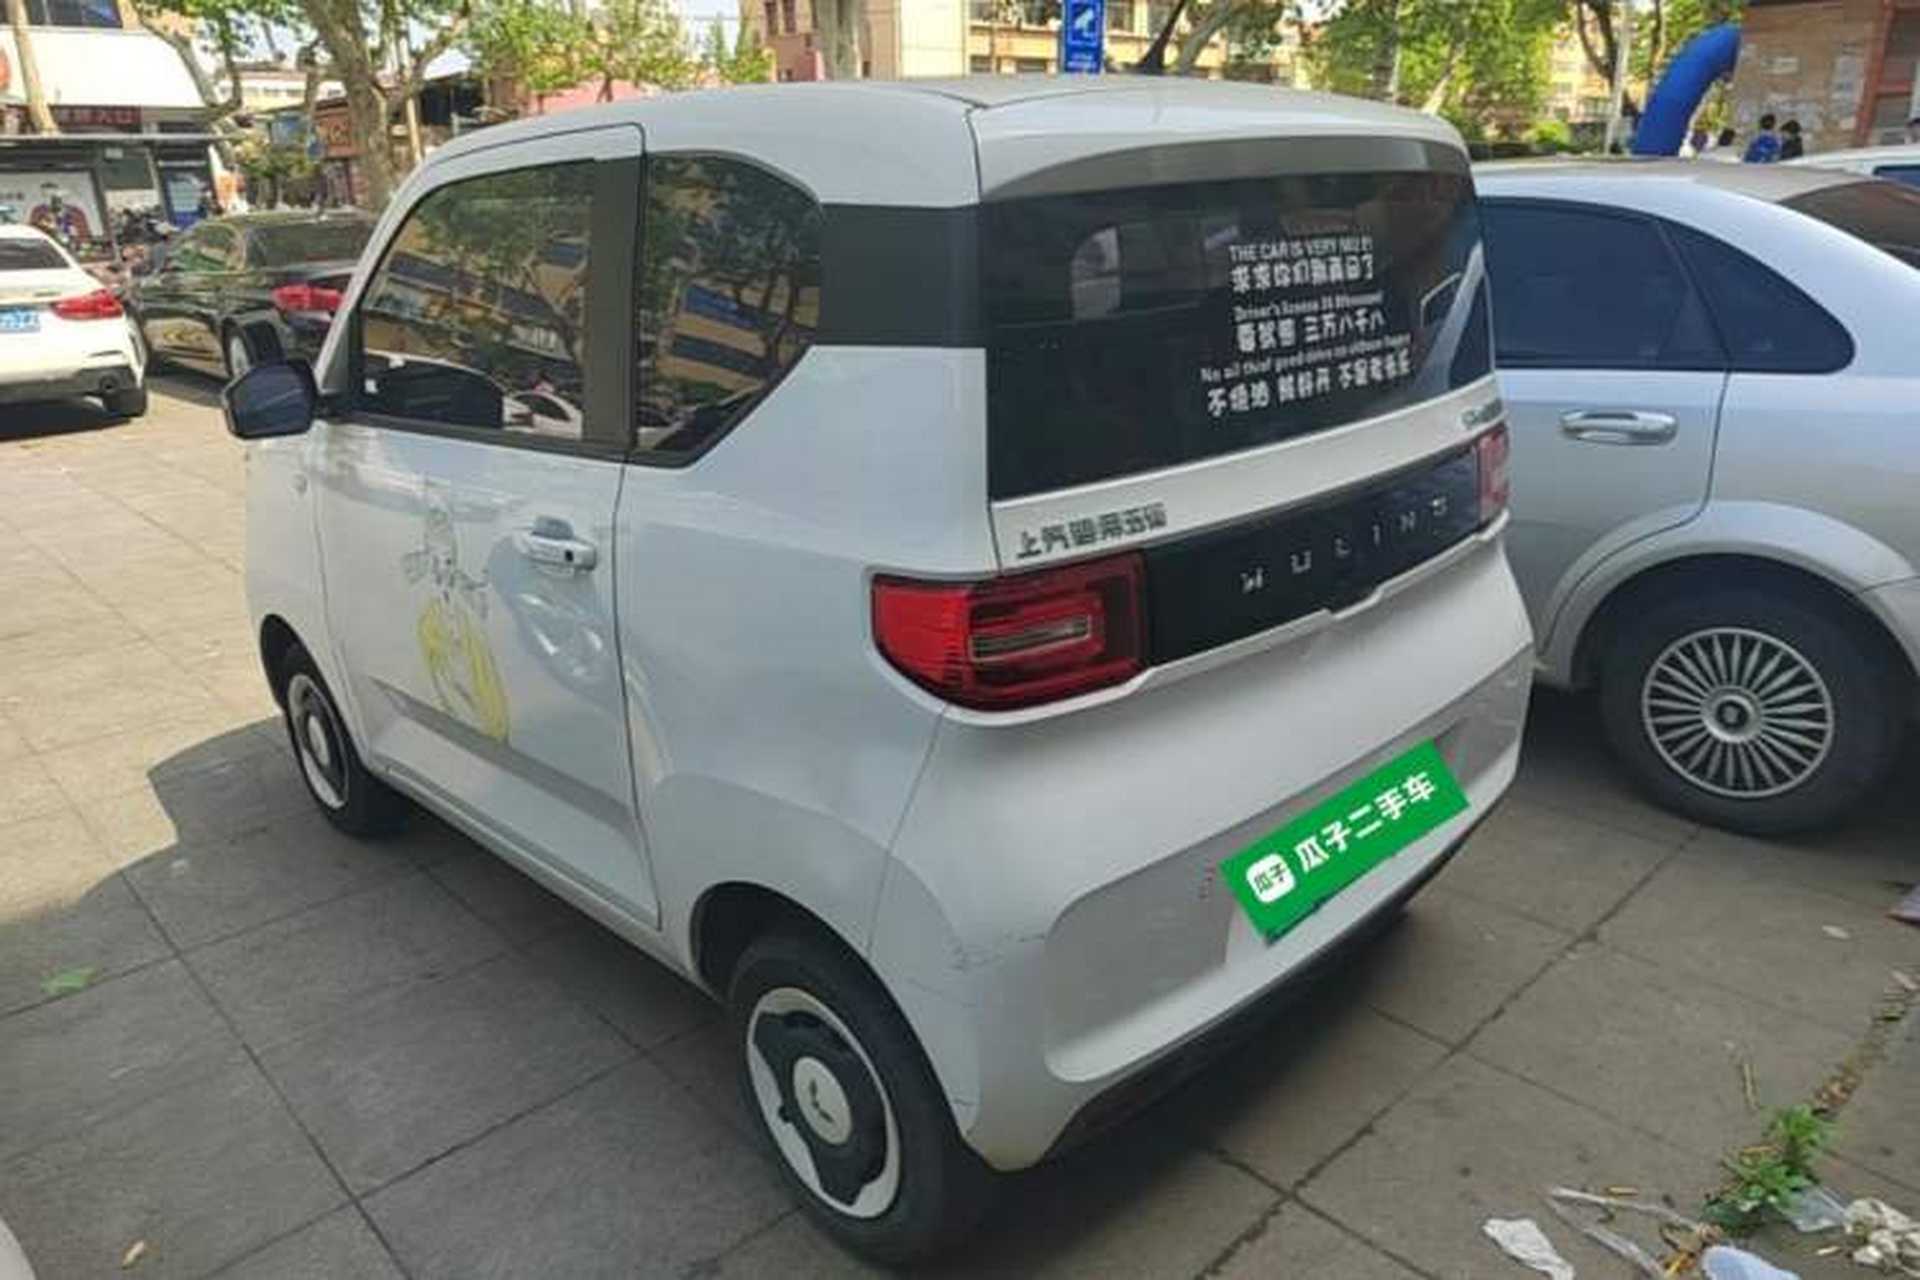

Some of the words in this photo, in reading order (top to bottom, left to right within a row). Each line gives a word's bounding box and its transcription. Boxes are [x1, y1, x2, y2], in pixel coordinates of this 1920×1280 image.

[1230, 244, 1257, 261] THE
[1259, 242, 1288, 259] CAR
[1290, 240, 1303, 258] IS
[1304, 307, 1385, 343] 三万八千八
